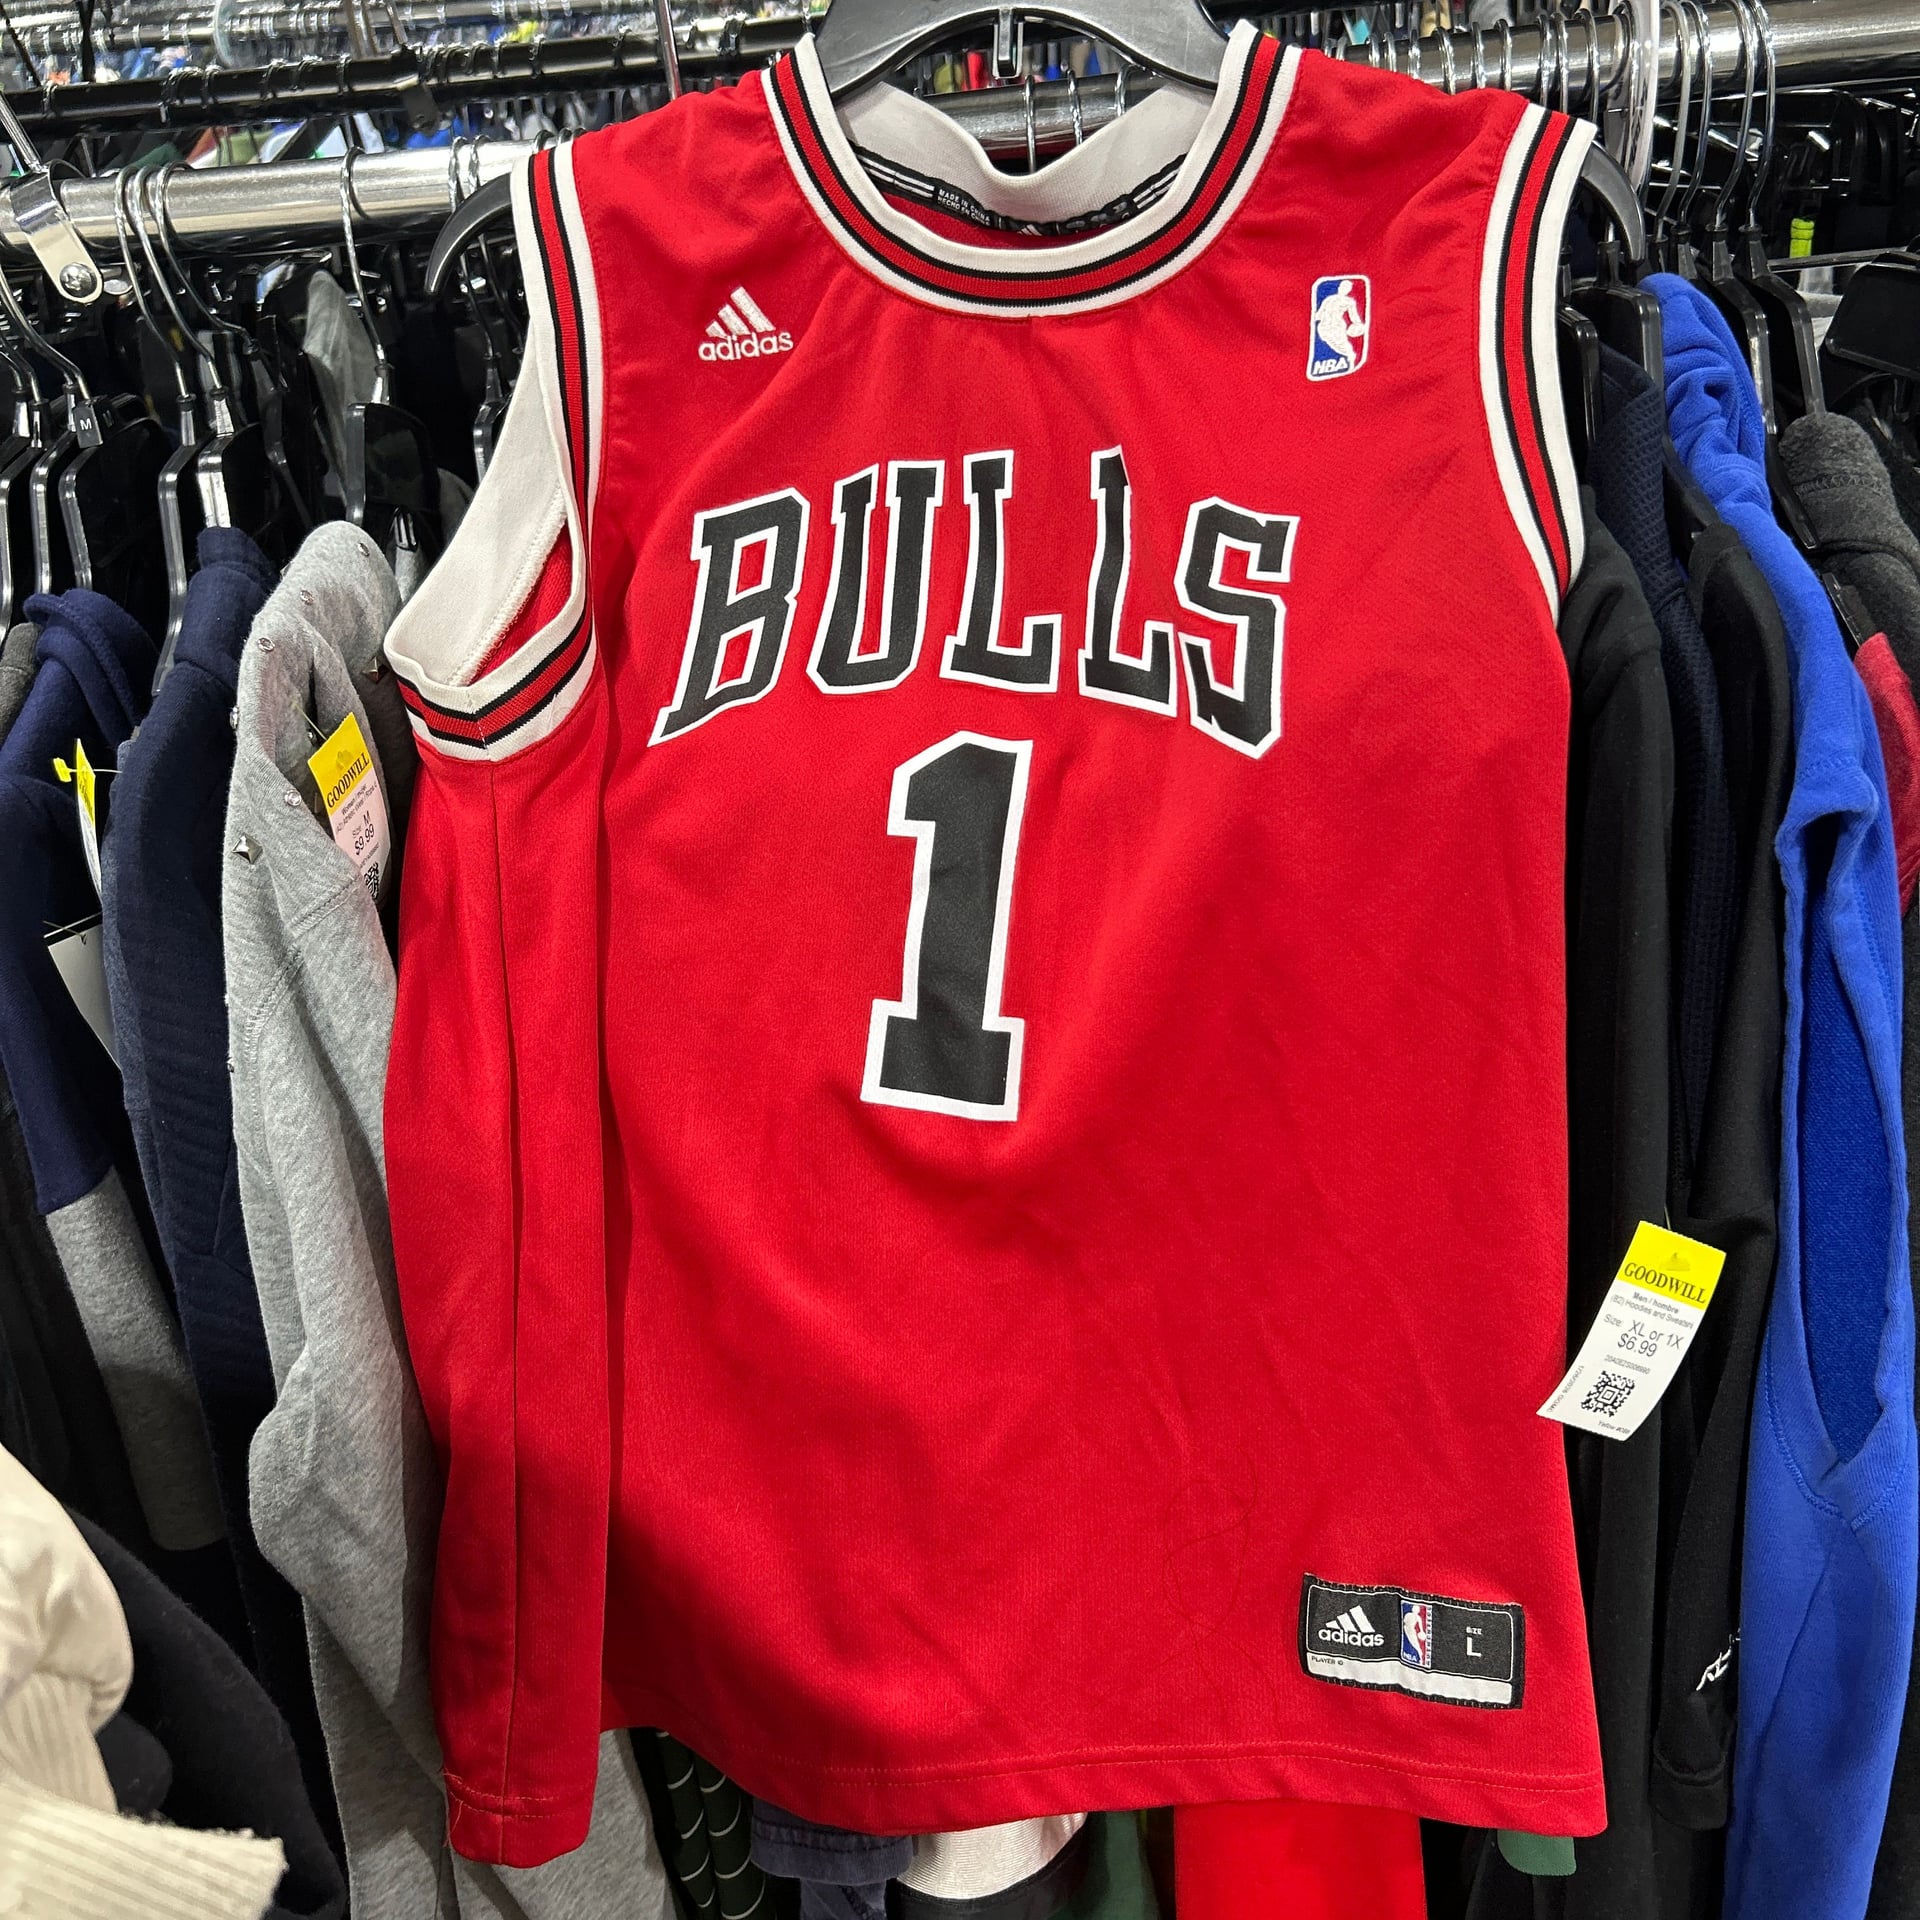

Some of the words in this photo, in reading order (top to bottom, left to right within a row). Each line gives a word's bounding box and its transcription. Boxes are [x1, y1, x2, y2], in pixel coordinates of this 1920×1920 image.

[939, 189, 959, 202] MADE
[961, 200, 969, 208] IN
[698, 332, 794, 361] adidas
[1312, 357, 1348, 375] NBA
[80, 418, 92, 430] M
[647, 445, 1299, 758] BULLS
[326, 753, 370, 809] GOODWILL
[363, 810, 371, 826] M
[354, 823, 375, 855] $9.99
[860, 731, 1033, 1121] 1
[1624, 1262, 1706, 1304] GOODWILL
[1625, 1299, 1651, 1315] Hoodies
[1652, 1309, 1666, 1320] and
[1633, 1292, 1648, 1303] Men
[1652, 1299, 1679, 1314] hombre
[1617, 1333, 1657, 1357] $6.99
[1628, 1320, 1645, 1338] XL
[1649, 1330, 1664, 1342] or
[1666, 1333, 1684, 1349] 1X
[1318, 1628, 1385, 1647] adidas
[1466, 1626, 1482, 1635] SIZE
[1403, 1651, 1417, 1662] NBA
[1466, 1637, 1482, 1657] L
[1311, 1655, 1336, 1665] PLAYER
